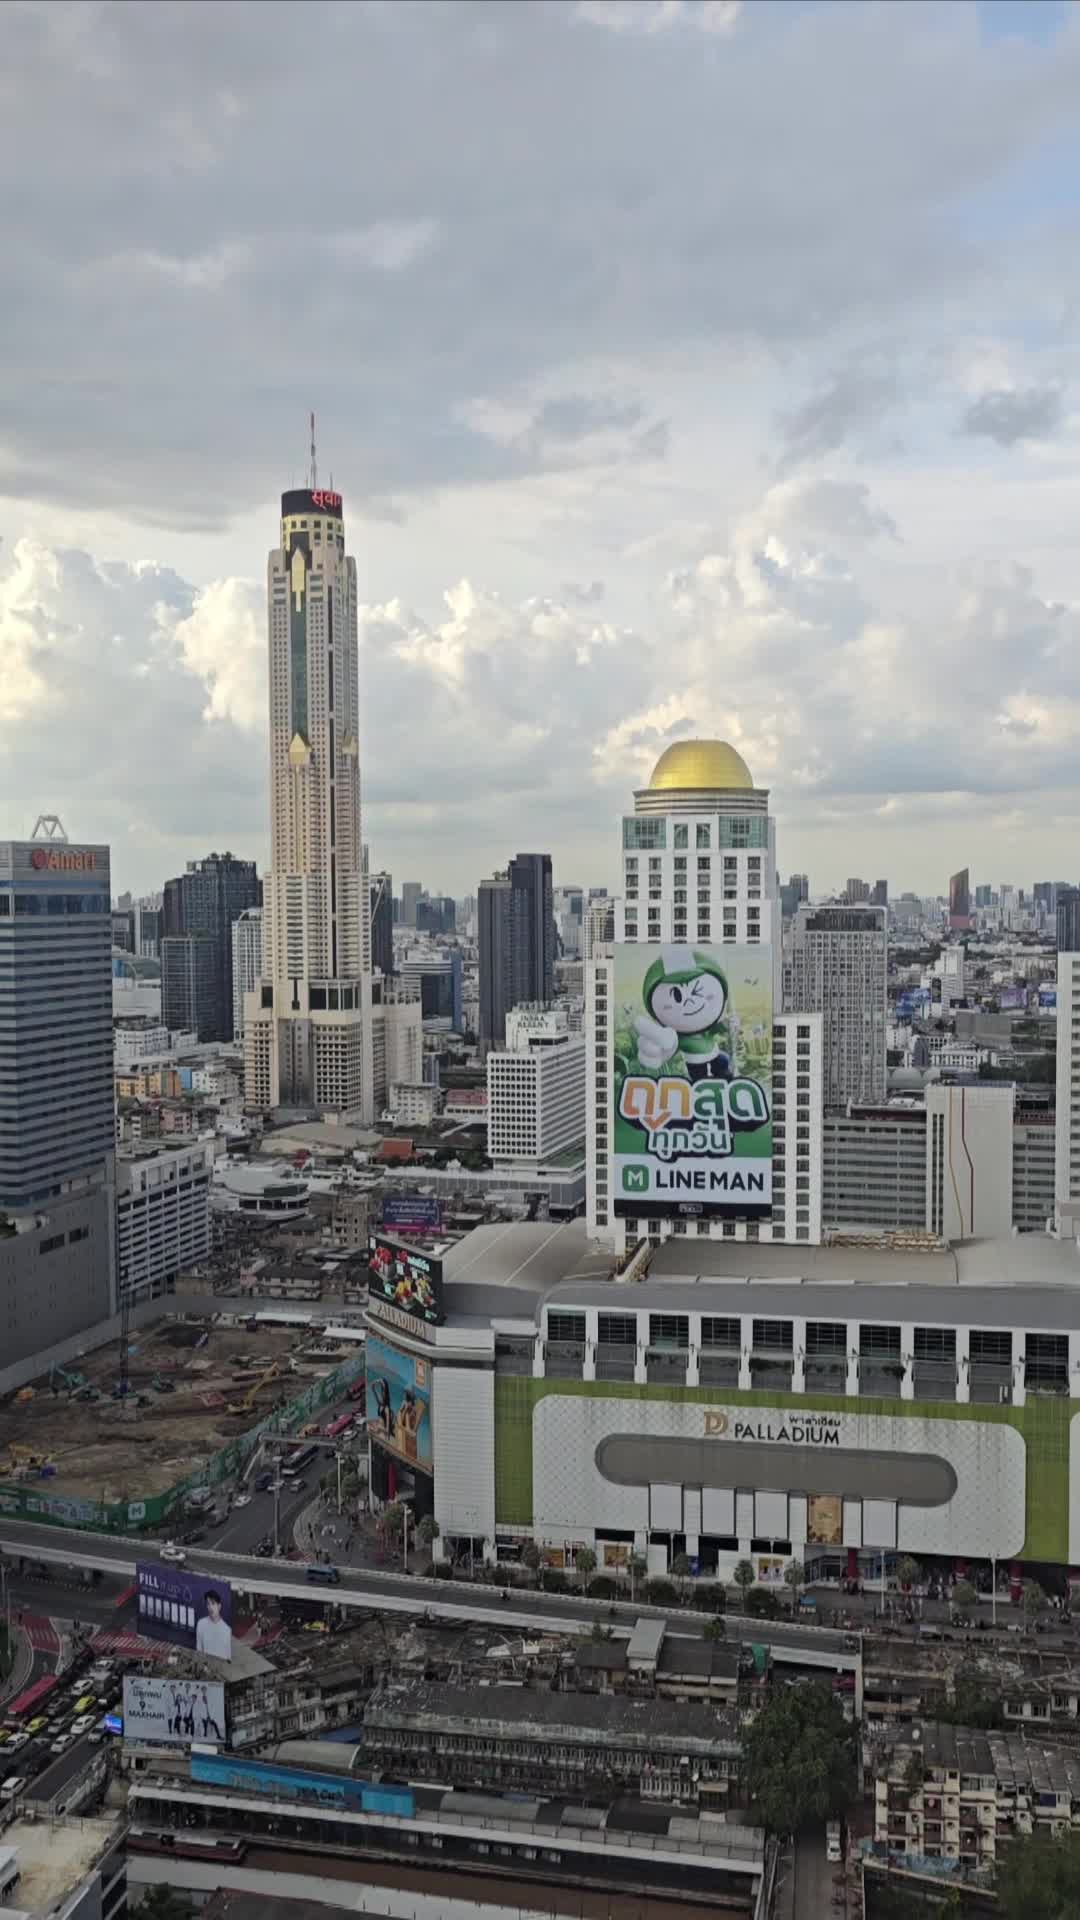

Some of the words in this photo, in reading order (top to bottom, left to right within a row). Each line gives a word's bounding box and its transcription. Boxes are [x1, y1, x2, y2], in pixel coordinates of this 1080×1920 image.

[47, 849, 96, 871] Amari
[622, 1079, 765, 1130] ถูกสุด
[651, 1122, 727, 1156] ทุกวัน
[376, 1304, 425, 1338] PALLADIUM
[734, 1423, 840, 1446] PALLADIUM
[139, 1572, 159, 1588] FILL
[129, 1709, 165, 1721] MAXHAIR
